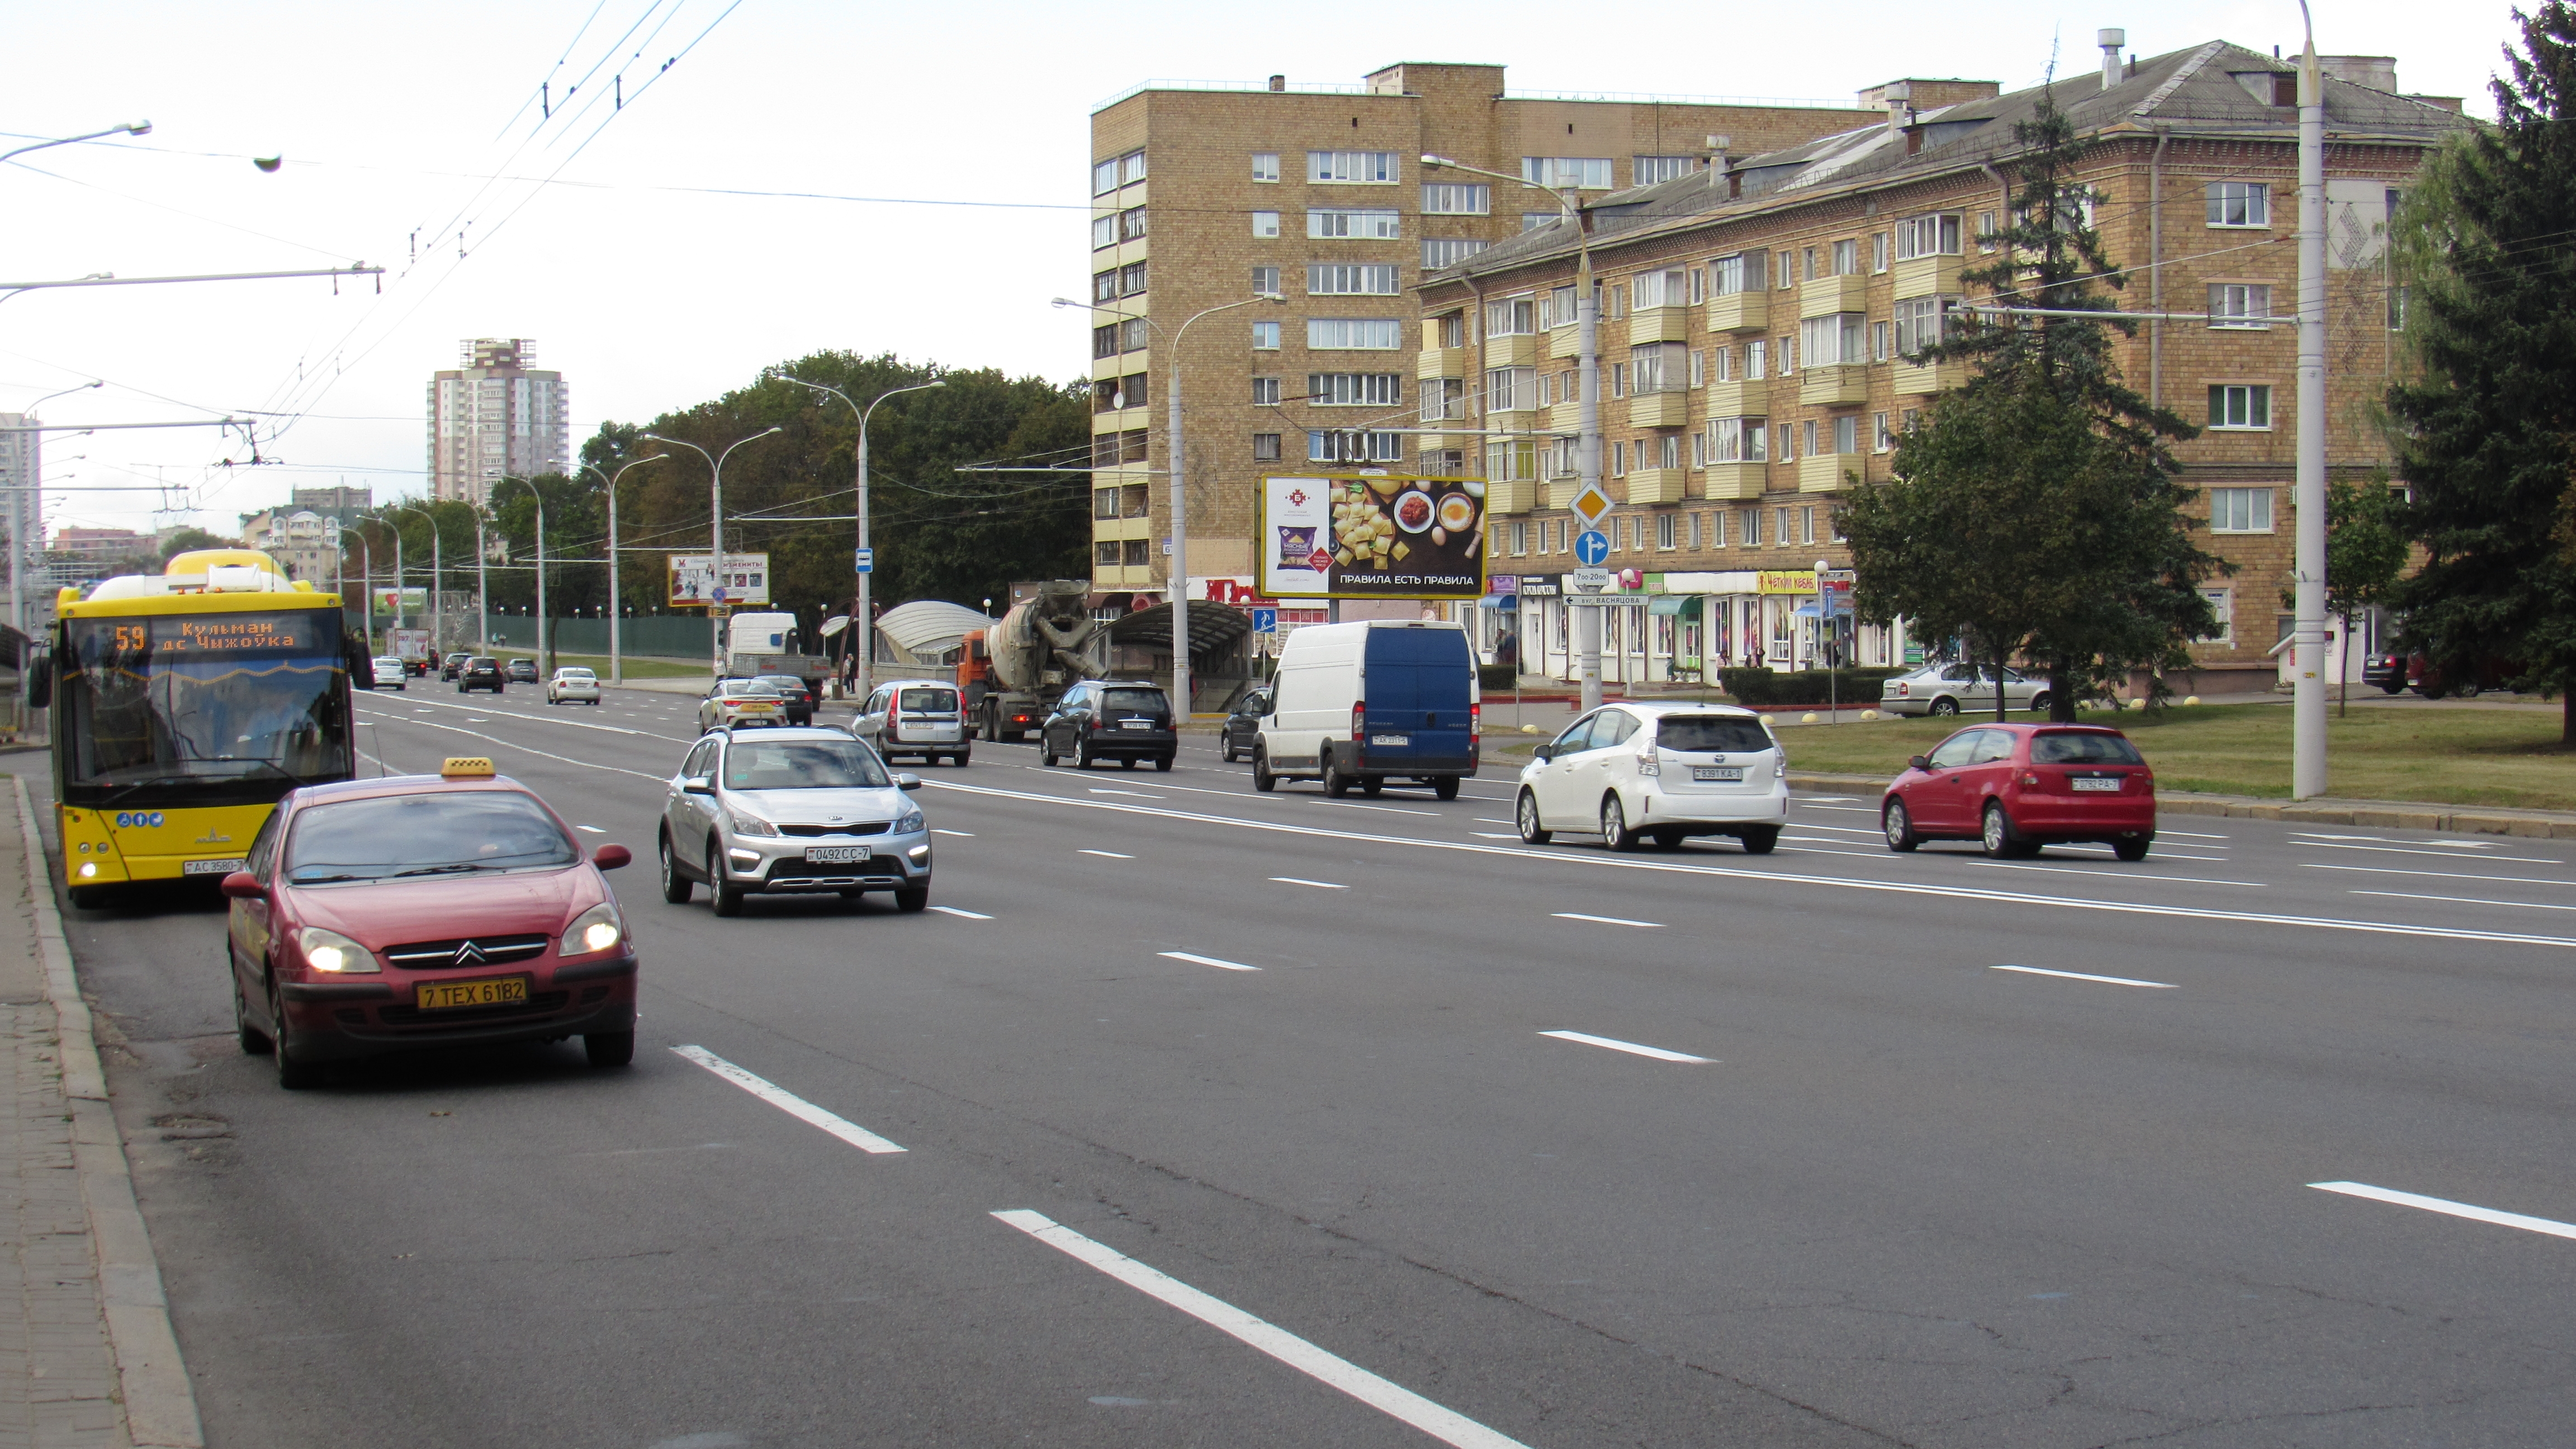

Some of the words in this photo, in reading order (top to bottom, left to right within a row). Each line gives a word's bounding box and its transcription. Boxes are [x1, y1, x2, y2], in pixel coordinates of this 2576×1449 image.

[1340, 575, 1391, 584] ПРАВИЛА
[1394, 576, 1421, 584] ЕСТЬ
[1424, 576, 1474, 585] ПРАВИЛА
[116, 626, 145, 650] 59
[182, 623, 273, 637] Кульман
[816, 849, 840, 859] 0492
[842, 848, 868, 859] CC-7
[195, 863, 209, 872] AC
[425, 989, 434, 1006] 7
[441, 986, 477, 1005] TEX
[483, 982, 523, 1002] 6182
